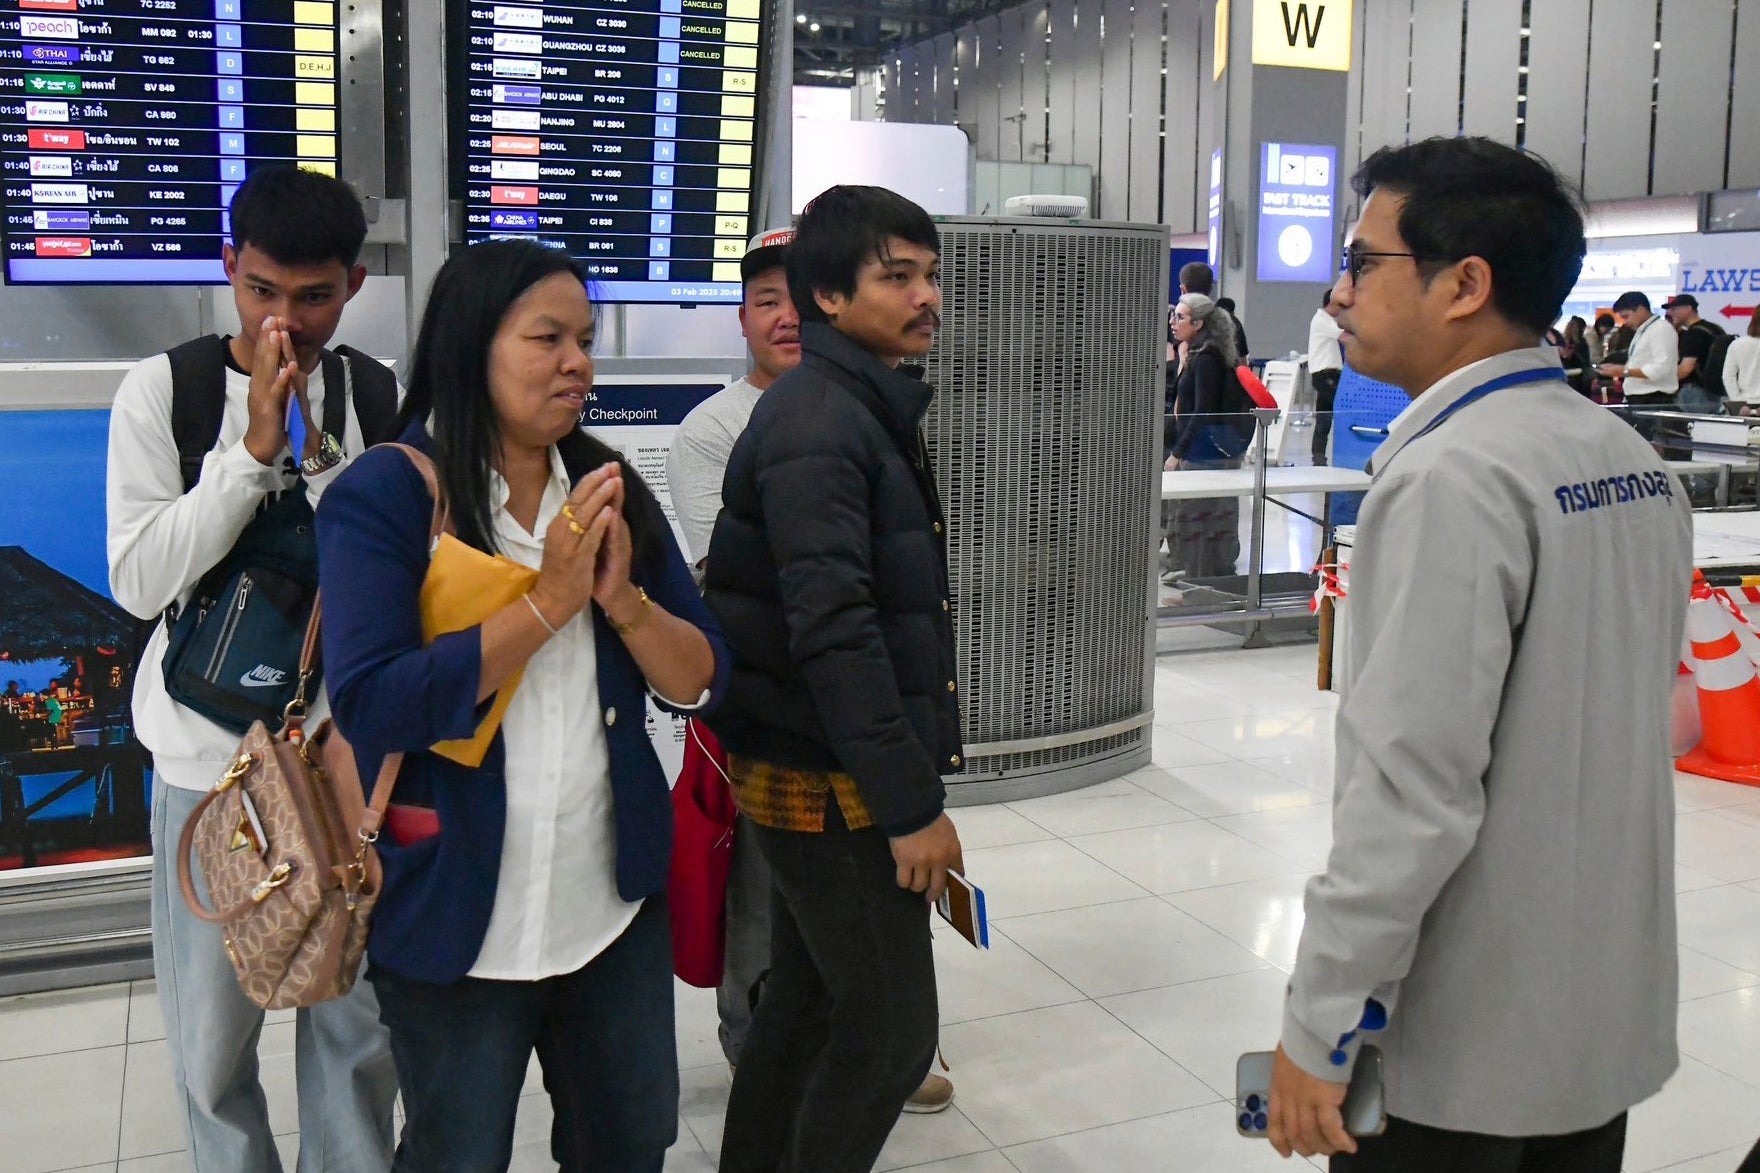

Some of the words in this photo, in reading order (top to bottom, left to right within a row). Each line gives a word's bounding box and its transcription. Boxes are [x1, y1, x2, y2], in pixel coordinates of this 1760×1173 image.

[225, 4, 233, 12] N
[682, 0, 723, 9] CANCELLED
[471, 10, 494, 19] 02:10
[543, 15, 574, 24] WUHAN
[596, 18, 607, 27] CZ
[681, 25, 722, 35] CANCELLED
[1281, 1, 1325, 48] W
[0, 22, 20, 30] 1:10
[26, 20, 73, 34] peach
[142, 28, 159, 36] MM
[188, 30, 213, 39] 01:30
[226, 32, 234, 40] L
[471, 36, 493, 45] 02:10
[543, 41, 593, 51] GUANGZHOU
[595, 44, 607, 52] CZ
[680, 50, 720, 60] CANCELLED
[45, 50, 67, 58] THAI
[143, 56, 157, 64] TG
[226, 58, 235, 67] D
[471, 62, 493, 71] 02:15
[542, 67, 567, 75] TAIPEI
[664, 73, 672, 82] S
[732, 78, 746, 86] R-S
[144, 83, 157, 91] SV
[226, 86, 235, 95] S
[470, 88, 493, 97] 02:15
[541, 92, 558, 100] ABU
[559, 94, 584, 102] DHABI
[606, 96, 625, 104] 4012
[0, 106, 26, 115] 01:30
[145, 110, 159, 118] CA
[228, 112, 236, 121] F
[470, 114, 492, 122] 02:20
[541, 118, 575, 126] NANJING
[593, 120, 606, 128] MU
[663, 122, 671, 132] L
[2, 134, 28, 142] 01:30
[146, 137, 162, 146] TW
[163, 137, 180, 146] 102
[228, 139, 238, 148] M
[469, 140, 492, 148] 02:25
[540, 143, 567, 151] SEOUL
[661, 147, 669, 156] N
[5, 161, 30, 170] 01:40
[230, 165, 237, 174] F
[469, 165, 491, 173] 02:25
[539, 168, 576, 176] QINGDAO
[659, 171, 668, 180] C
[6, 189, 32, 197] 01:40
[149, 191, 162, 199] KE
[163, 191, 185, 199] 2002
[469, 190, 491, 198] 02:30
[539, 192, 567, 200] DAEGU
[590, 193, 604, 201] TW
[659, 195, 668, 204] M
[1290, 193, 1331, 207] TRACK
[8, 216, 33, 224] 01:45
[150, 217, 164, 225] PG
[468, 215, 491, 223] 02:35
[538, 216, 564, 225] TAIPEI
[589, 218, 598, 226] CI
[658, 219, 666, 228] P
[10, 243, 36, 251] 01:45
[151, 243, 164, 251] VZ
[588, 242, 600, 250] BR
[656, 267, 664, 276] B
[671, 288, 682, 296] 03
[682, 288, 697, 296] Feb
[698, 288, 719, 296] 2025
[589, 407, 658, 422] Checkpoint
[250, 664, 286, 682] NIKE
